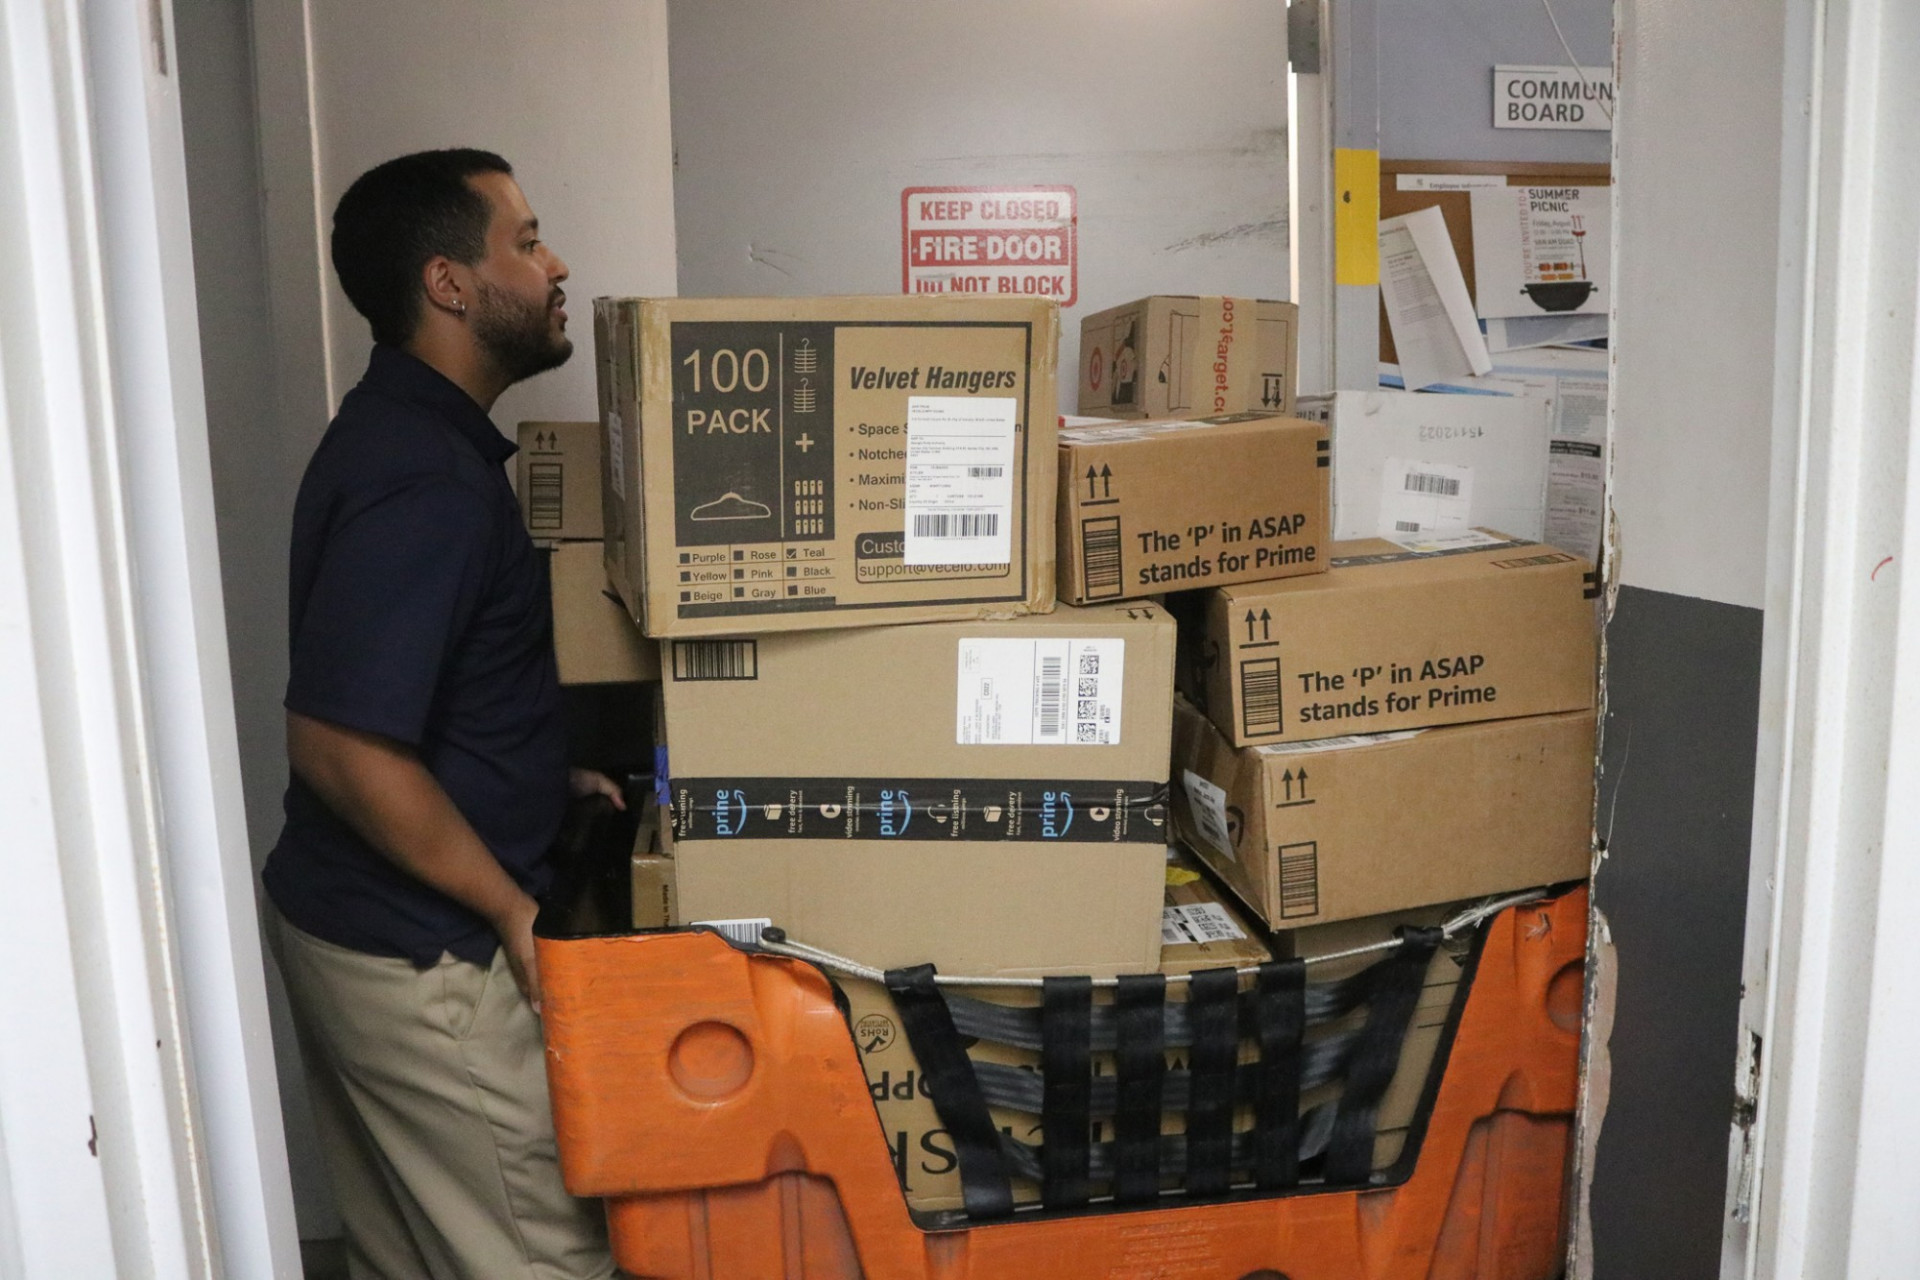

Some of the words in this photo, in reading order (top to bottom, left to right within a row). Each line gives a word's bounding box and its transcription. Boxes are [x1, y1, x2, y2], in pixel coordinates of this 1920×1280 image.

[1507, 79, 1612, 101] COMMUN
[1507, 102, 1585, 123] BOARD
[1528, 188, 1580, 200] SUMMER
[920, 201, 973, 221] KEEP
[980, 200, 1060, 220] CLOSED
[1530, 201, 1569, 213] PICNIC
[1519, 209, 1530, 246] INVITED
[919, 235, 979, 261] FIRE
[986, 235, 1062, 261] DOOR
[950, 276, 991, 294] NOT
[997, 275, 1065, 295] BLOCK
[683, 347, 771, 393] 100
[850, 366, 919, 390] Velvet
[925, 366, 1017, 394] Hangers
[687, 408, 772, 435] PACK
[858, 423, 900, 437] Space
[1138, 530, 1180, 553] The
[1222, 522, 1241, 543] in
[1248, 513, 1306, 541] ASAP
[692, 553, 726, 563] Purple
[751, 550, 777, 560] Rose
[803, 548, 825, 558] Teal
[803, 566, 832, 577] Black
[1139, 556, 1212, 585] stands
[1218, 551, 1249, 574] for
[1255, 544, 1316, 569] Prime
[692, 571, 727, 582] Yellow
[751, 569, 774, 579] Pink
[693, 590, 723, 601] Beige
[751, 588, 777, 599] Gray
[804, 585, 827, 595] Blue
[1298, 671, 1345, 694] The
[1390, 663, 1412, 684] in
[1419, 654, 1485, 681] ASAP
[1300, 695, 1379, 723] stands
[1385, 692, 1421, 713] for
[1428, 685, 1496, 709] Prime
[678, 819, 686, 837] free
[787, 817, 796, 833] free
[845, 818, 853, 838] video
[950, 820, 959, 837] free
[1006, 819, 1015, 836] free
[1112, 821, 1121, 841] video
[860, 1028, 889, 1037] RoHS
